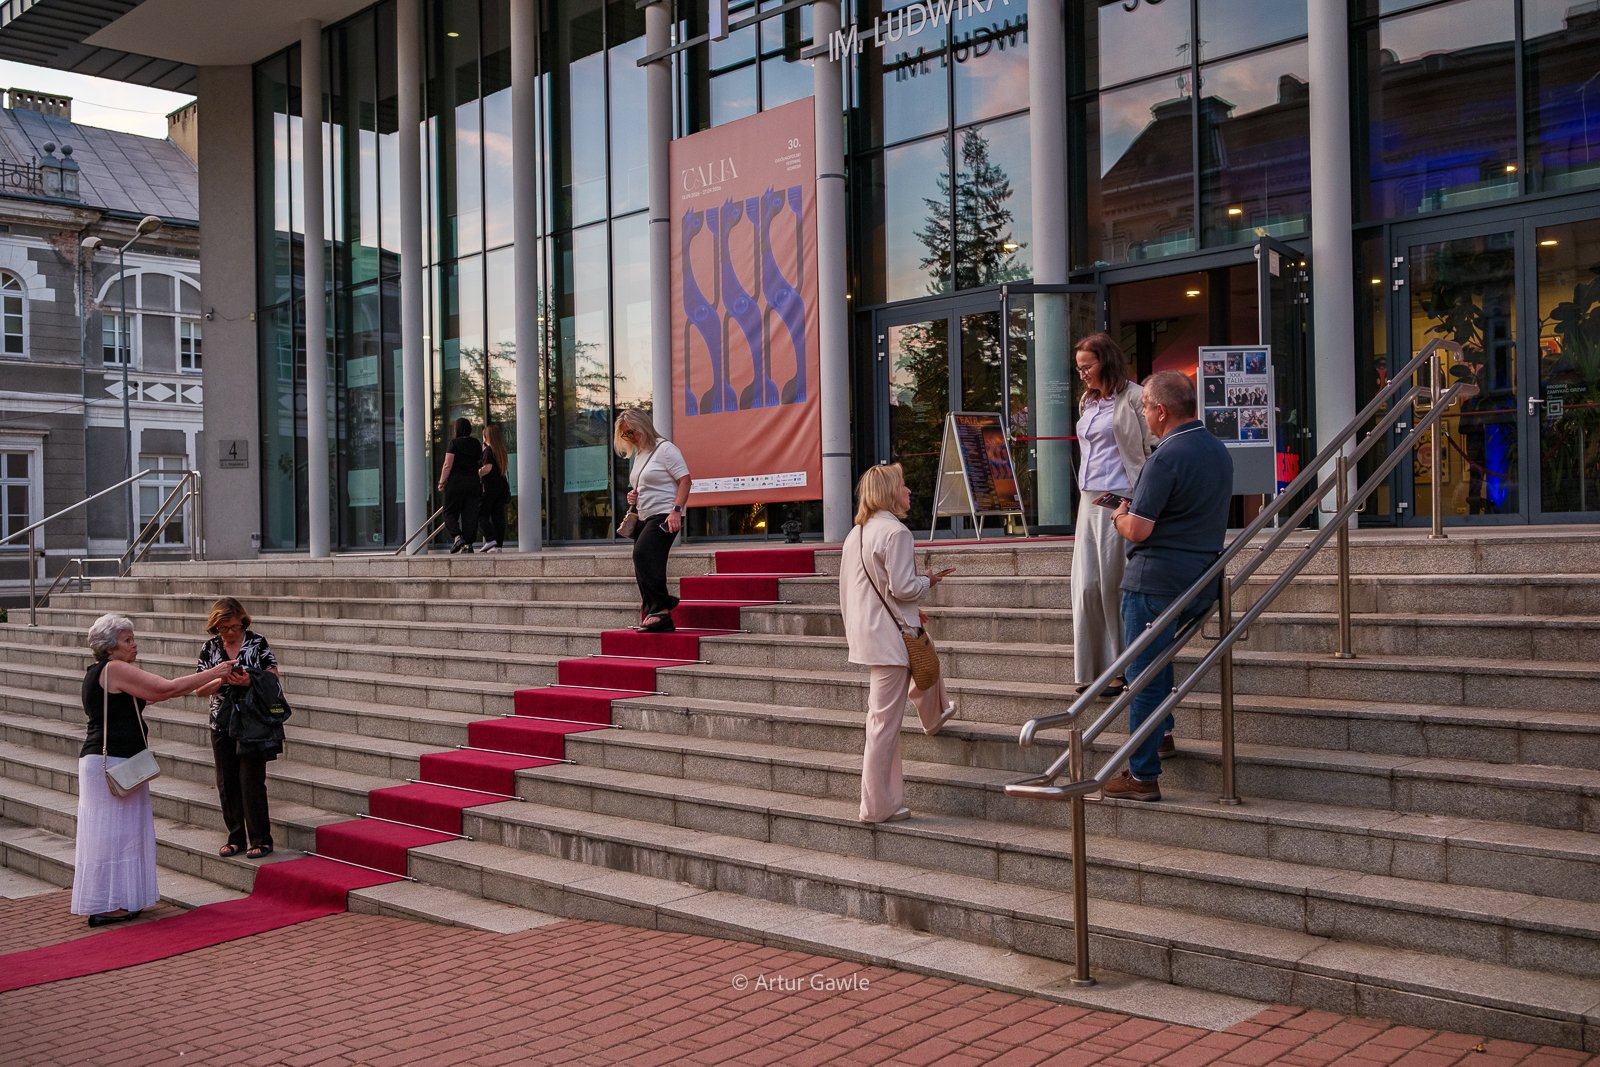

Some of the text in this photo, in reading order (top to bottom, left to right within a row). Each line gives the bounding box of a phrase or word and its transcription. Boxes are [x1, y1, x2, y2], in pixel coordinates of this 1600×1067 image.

[829, 25, 864, 63] IM.
[788, 138, 801, 150] 30.
[682, 157, 739, 192] TALIA
[229, 441, 238, 460] 4
